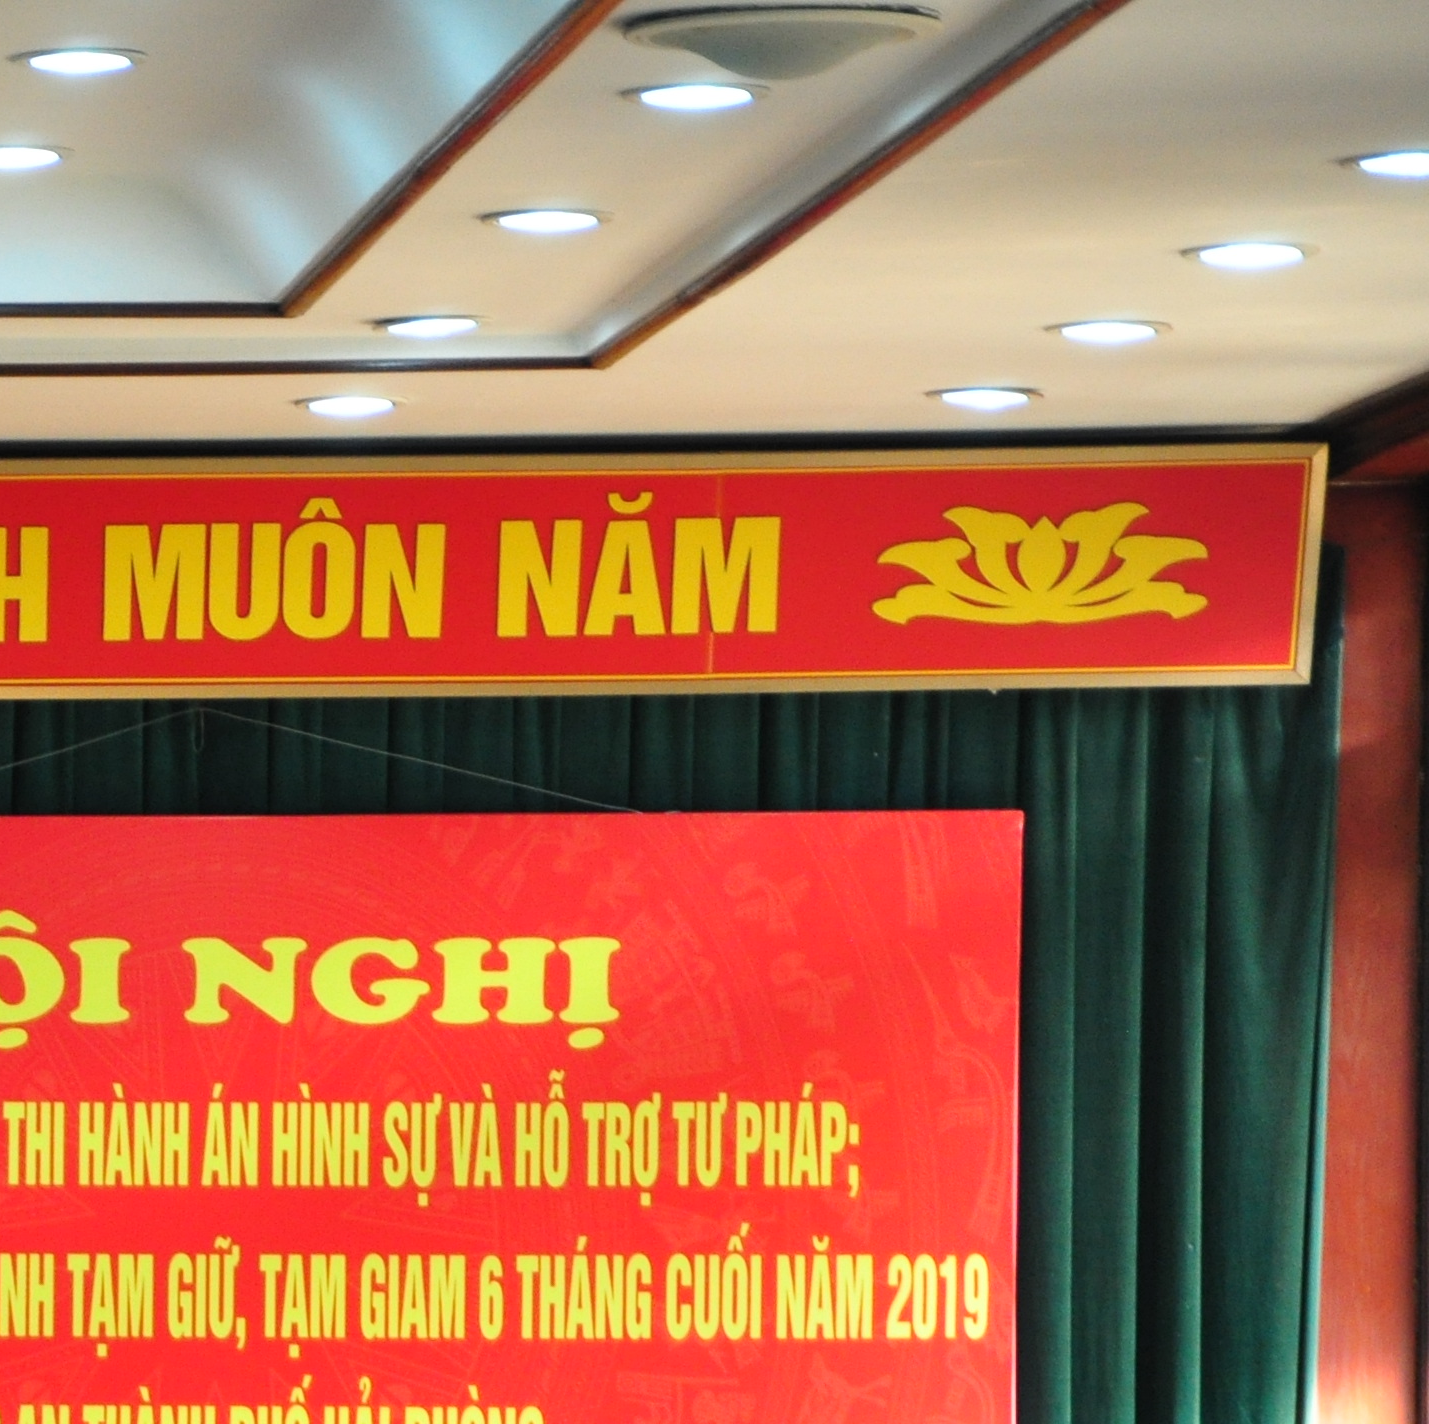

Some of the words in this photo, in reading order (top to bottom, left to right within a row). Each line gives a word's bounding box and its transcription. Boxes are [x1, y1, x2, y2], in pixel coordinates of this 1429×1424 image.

[102, 498, 446, 640] MUÔN
[496, 491, 782, 638] NĂM
[181, 937, 622, 1050] NGHỊ
[2, 1101, 66, 1186] THI
[78, 1083, 190, 1187] HÀNH
[201, 1083, 259, 1187] ÁN
[272, 1083, 370, 1187] HÌNH
[382, 1093, 443, 1207] SỰ
[449, 1083, 502, 1187] VÀ
[514, 1069, 570, 1189] HỖ
[582, 1092, 662, 1207] TRỢ
[672, 1092, 728, 1188] TƯ
[735, 1082, 860, 1198] PHÁP;
[67, 1253, 154, 1358] TẠM
[167, 1236, 247, 1350] GIỮ,
[259, 1254, 347, 1359] TẠM
[360, 1253, 466, 1340] GIAM
[479, 1254, 504, 1341] 6
[515, 1235, 652, 1341] THÁNG
[665, 1222, 763, 1341] CUỐI
[775, 1235, 874, 1341] NĂM
[885, 1252, 990, 1342] 2019
